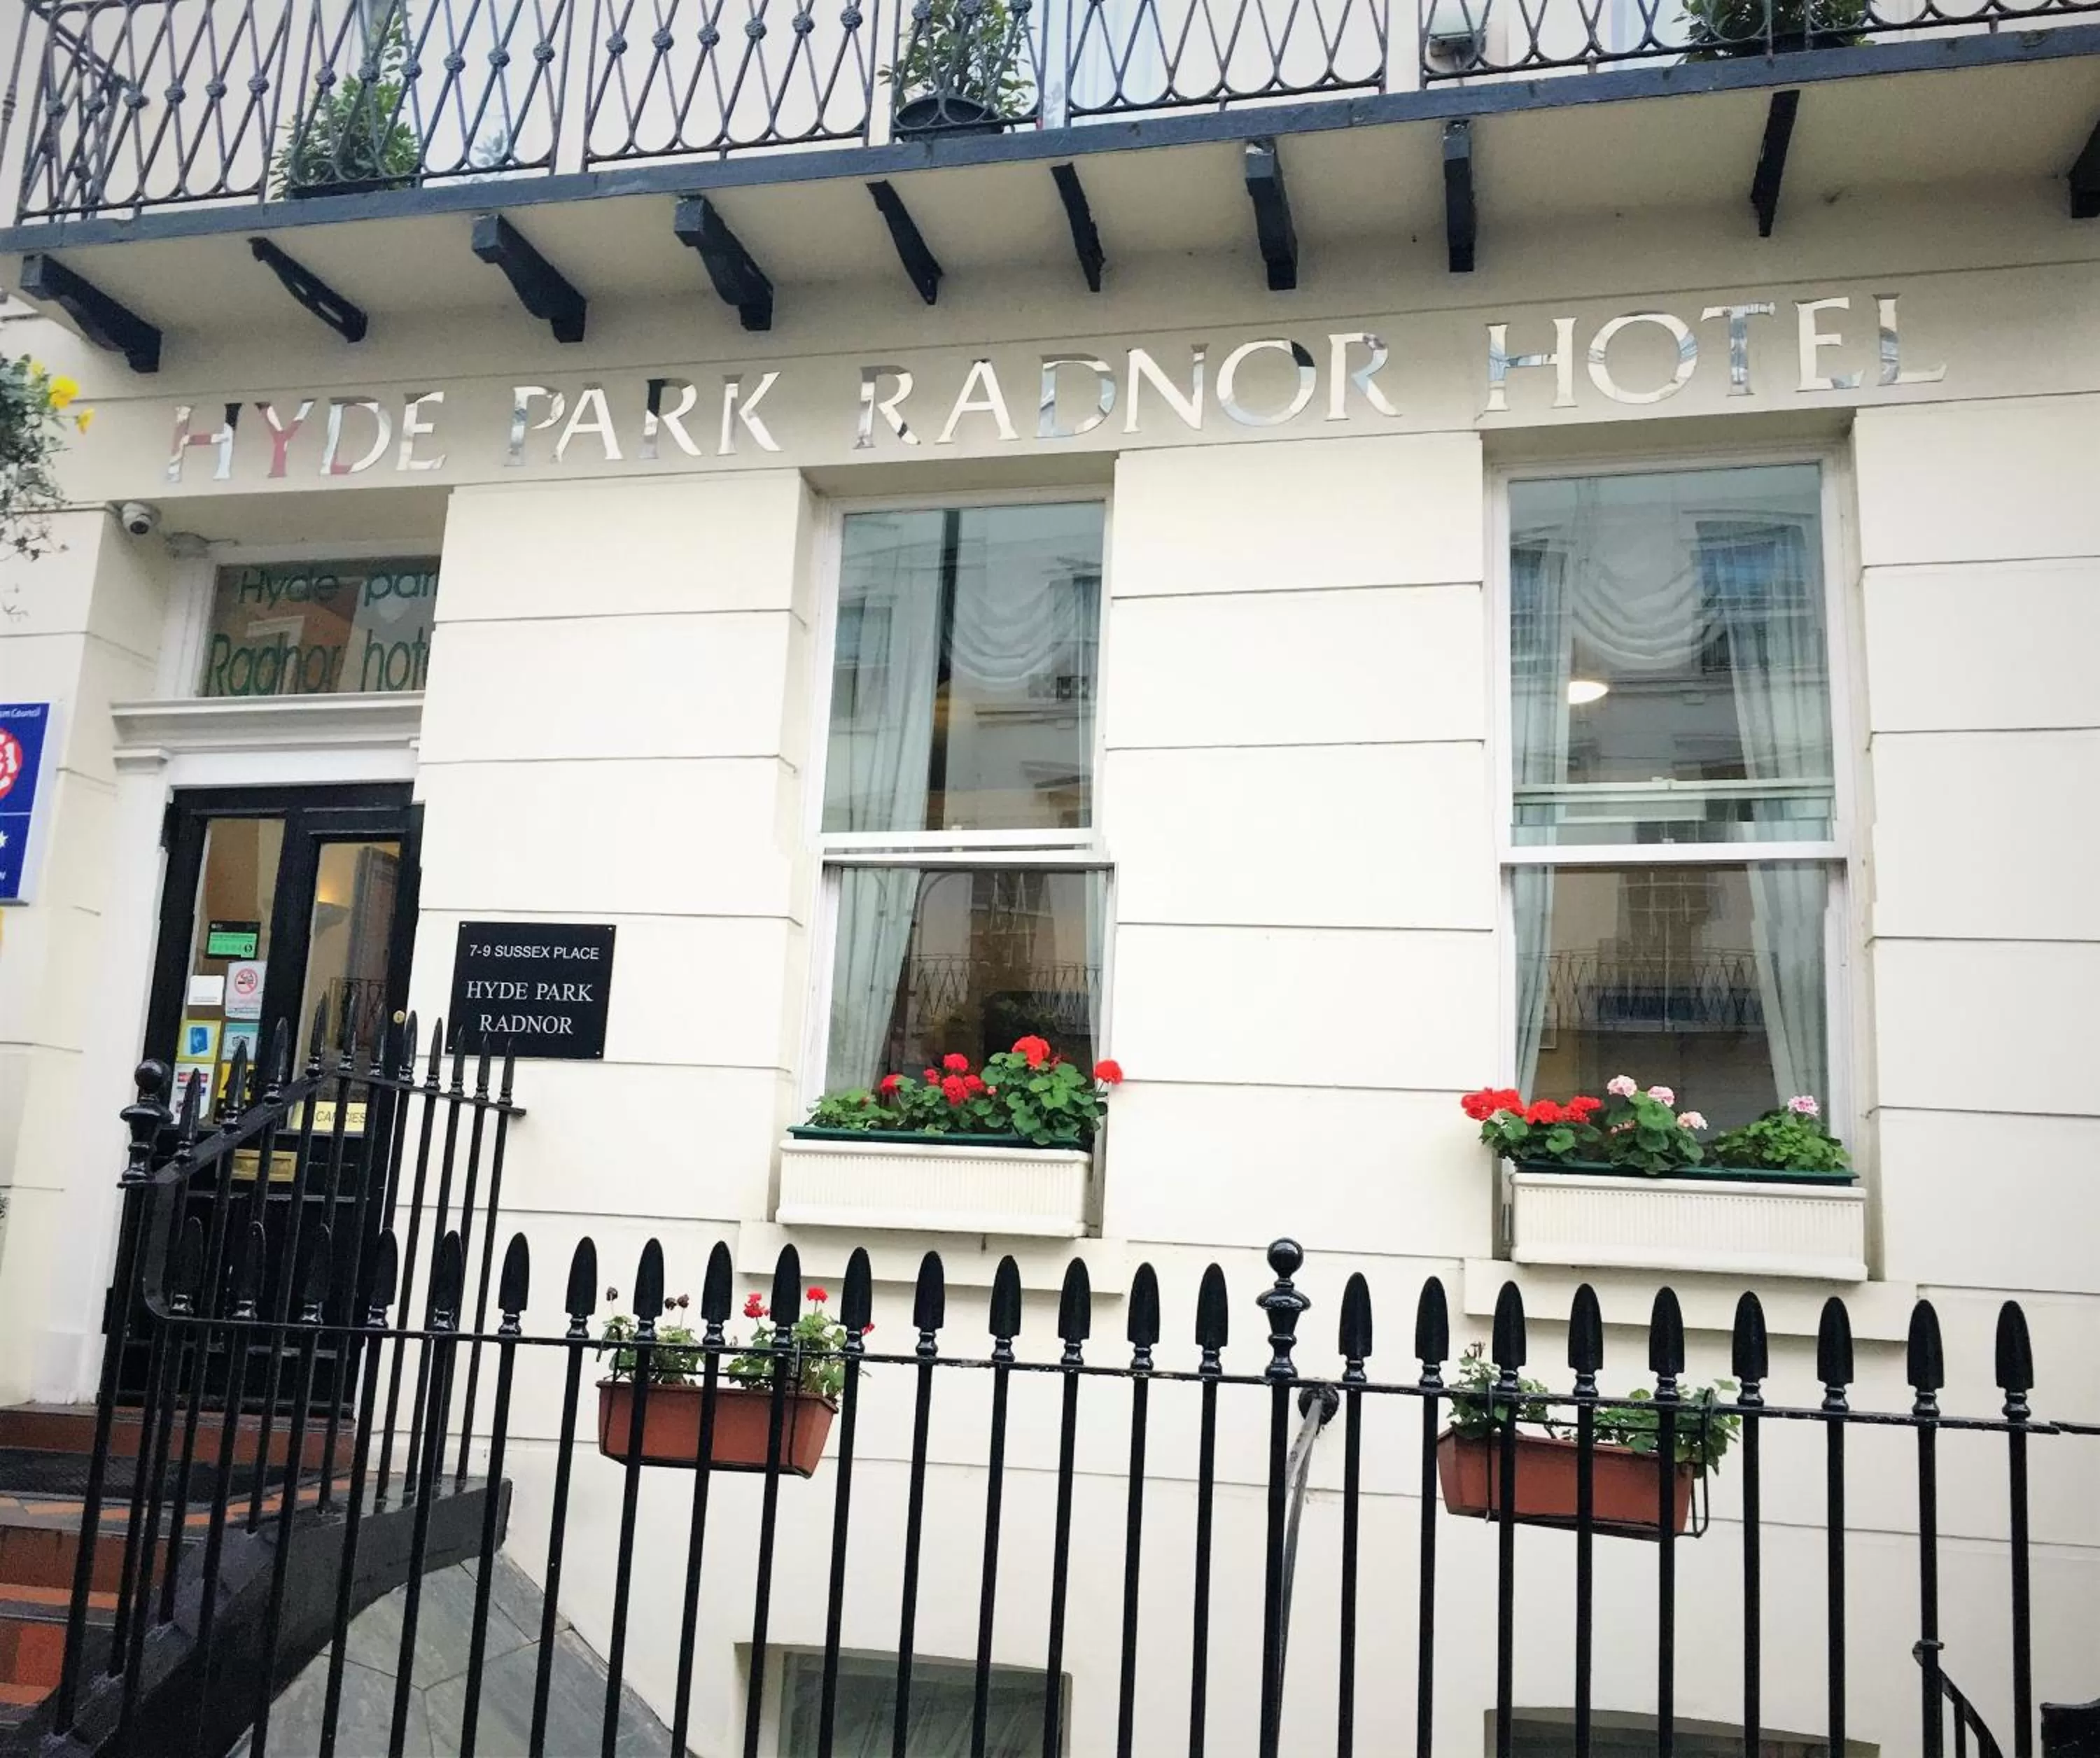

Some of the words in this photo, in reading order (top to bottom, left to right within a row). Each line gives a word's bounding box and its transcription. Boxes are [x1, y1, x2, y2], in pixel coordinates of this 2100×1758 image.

[165, 389, 444, 483] HYDE
[503, 370, 784, 467] PARK
[852, 332, 1403, 449] RADNOR
[1485, 293, 1948, 412] HOTEL
[237, 566, 340, 611] Hyde
[363, 571, 438, 607] par
[469, 944, 491, 957] 7-9
[494, 945, 550, 959] SUSSEX
[553, 947, 600, 960] PLACE
[465, 980, 529, 1000] HYDE
[534, 983, 594, 1002] PARK
[479, 1014, 574, 1034] RADNOR
